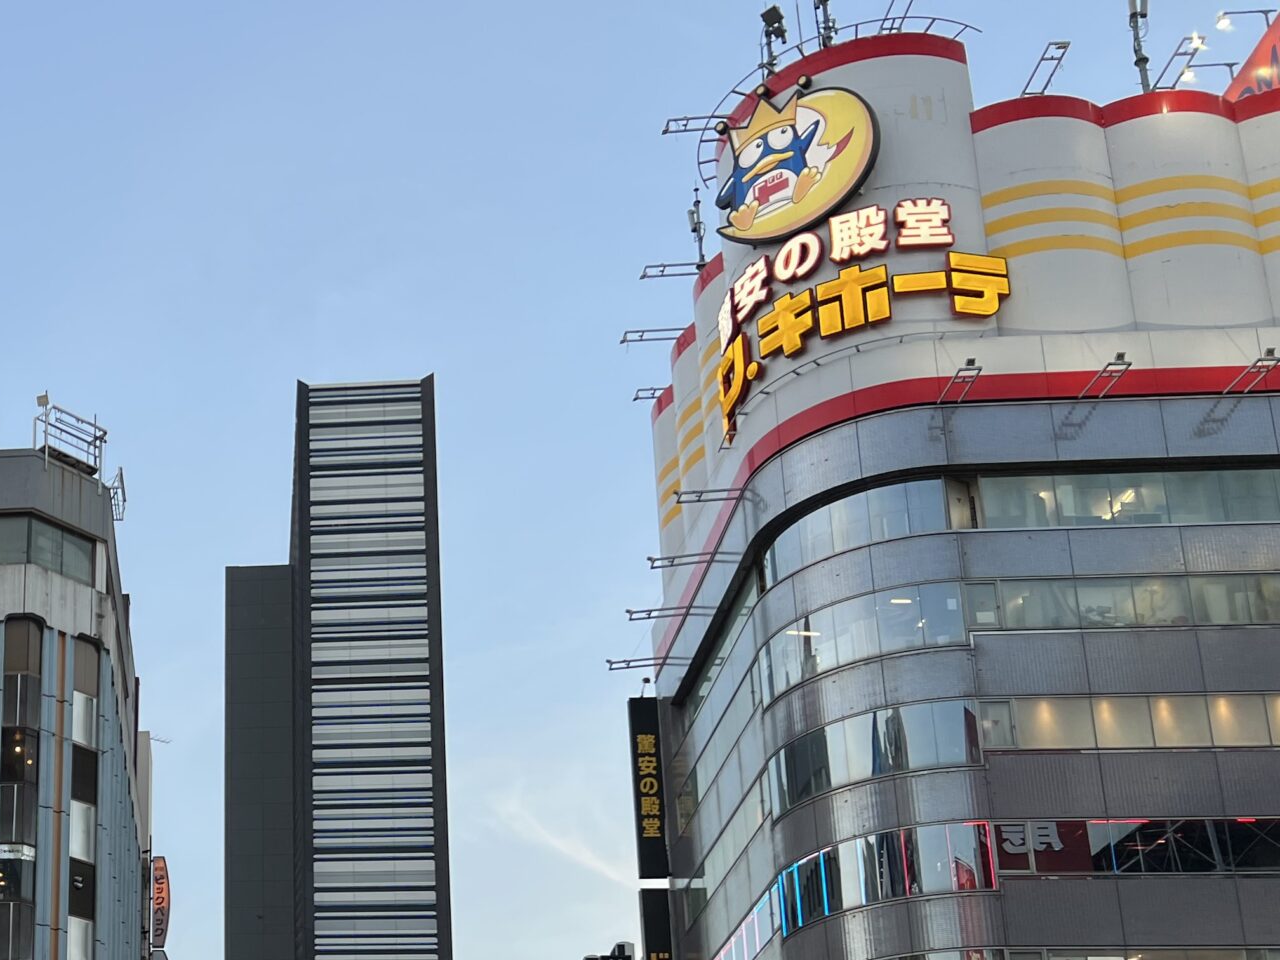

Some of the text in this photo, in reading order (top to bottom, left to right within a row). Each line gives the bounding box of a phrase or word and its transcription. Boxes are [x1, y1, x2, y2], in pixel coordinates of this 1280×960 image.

[637, 733, 662, 838] 驚安の殿堂
